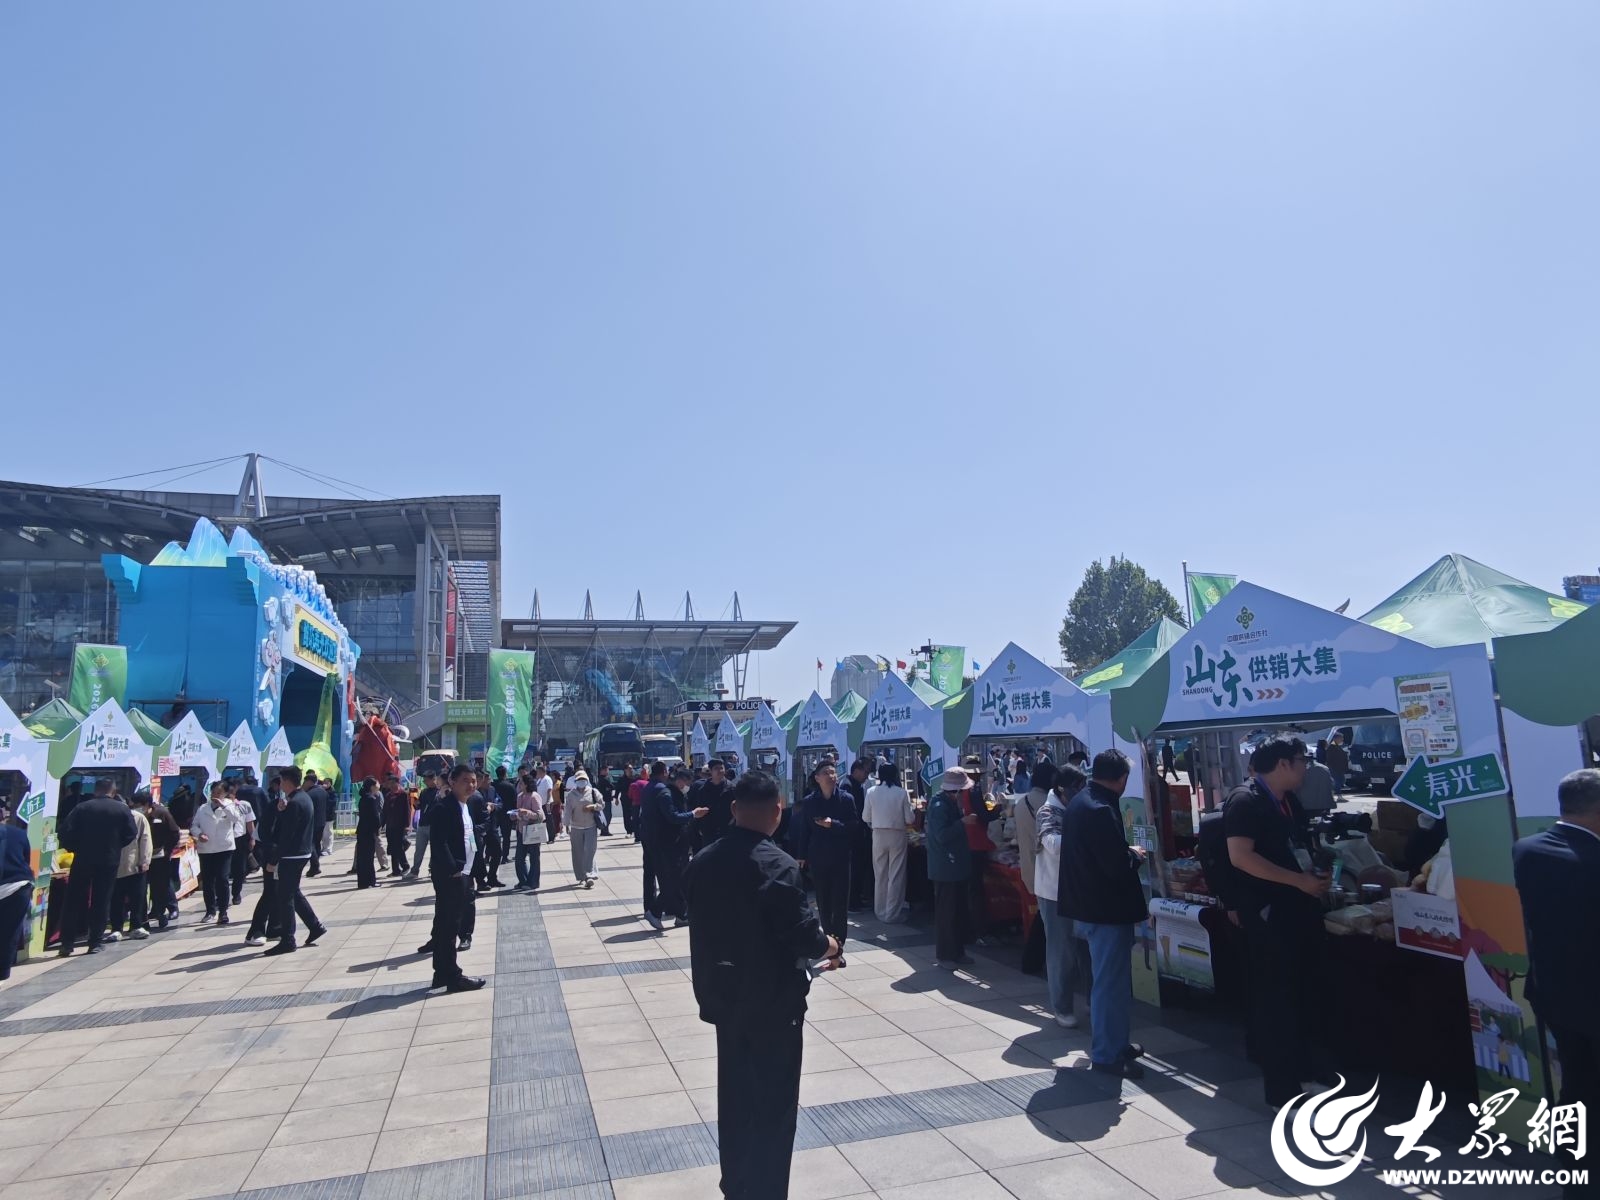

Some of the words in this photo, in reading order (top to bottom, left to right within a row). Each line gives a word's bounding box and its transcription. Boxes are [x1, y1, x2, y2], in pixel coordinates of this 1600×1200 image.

[1186, 644, 1254, 708] 山东
[1247, 646, 1338, 683] 供销大集
[1181, 685, 1214, 697] SHANDONG
[698, 702, 721, 711] 公安
[981, 682, 1014, 728] 山东
[1011, 690, 1052, 711] 供销大集
[1362, 751, 1393, 759] POLICE
[1423, 764, 1481, 801] 寿光
